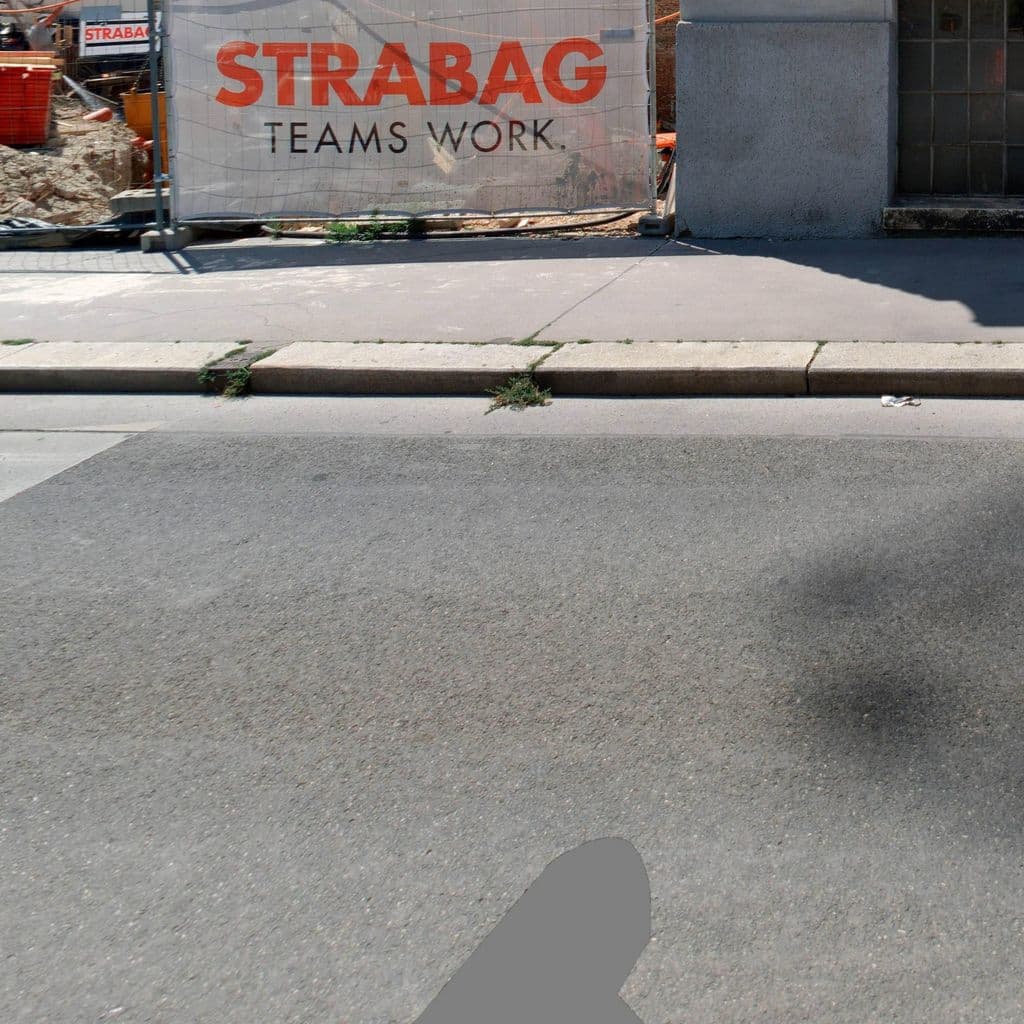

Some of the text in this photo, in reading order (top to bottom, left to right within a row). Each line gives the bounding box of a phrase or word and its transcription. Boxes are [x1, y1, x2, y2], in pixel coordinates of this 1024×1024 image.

[215, 37, 608, 108] STRABAG
[264, 118, 567, 154] TEAMS WORK.
